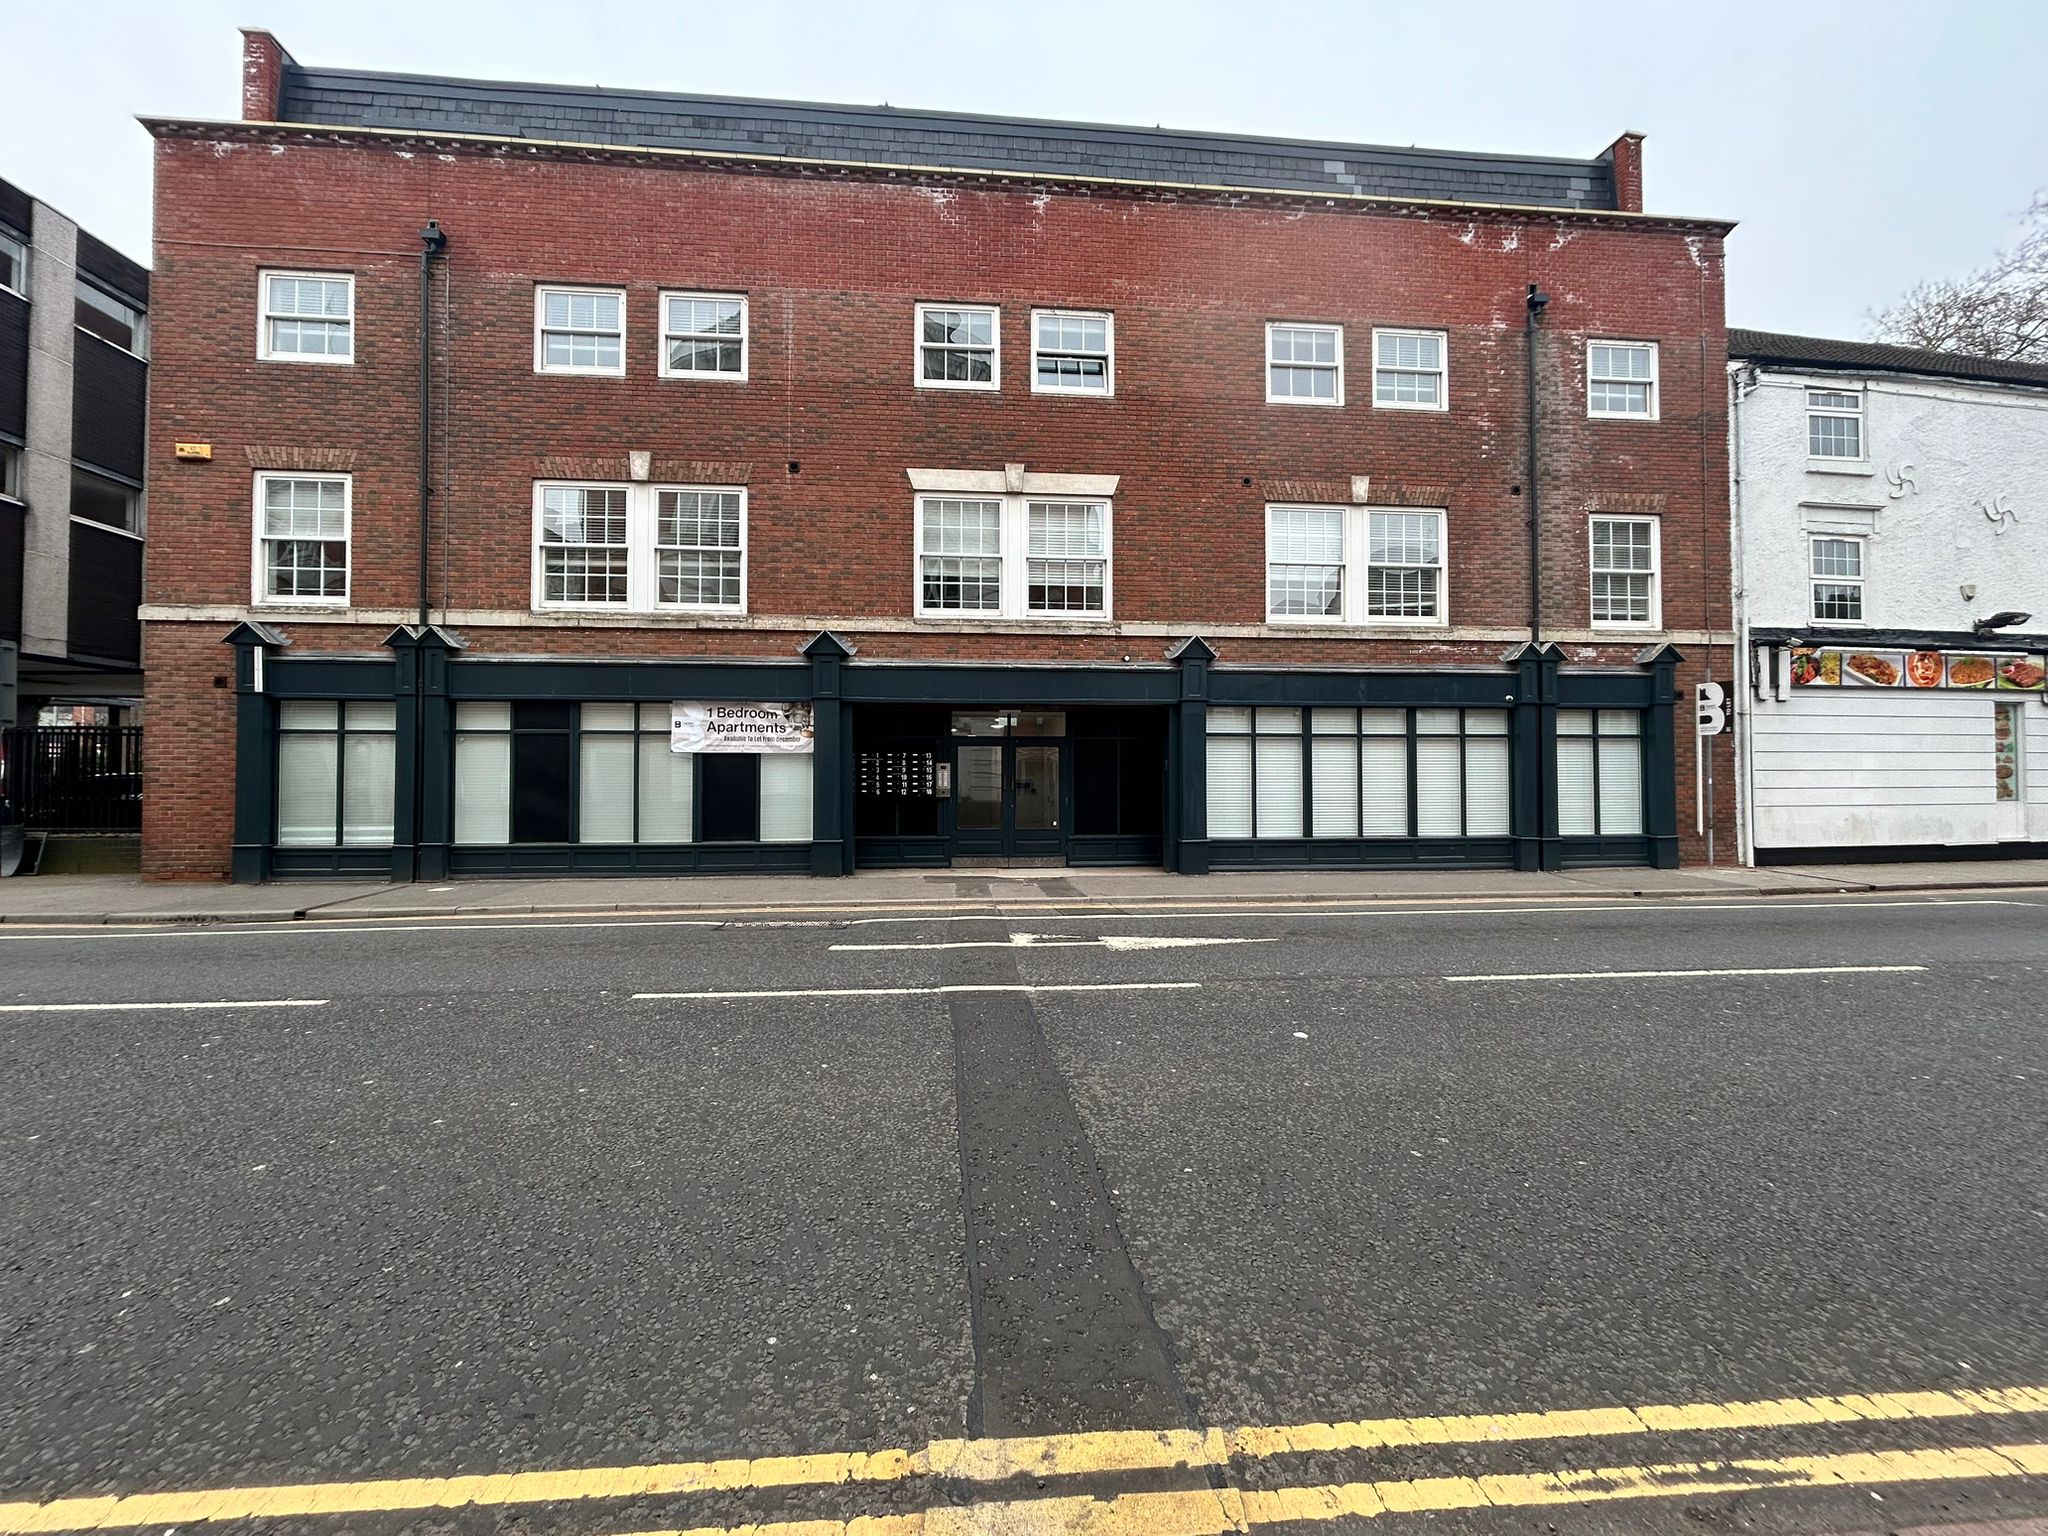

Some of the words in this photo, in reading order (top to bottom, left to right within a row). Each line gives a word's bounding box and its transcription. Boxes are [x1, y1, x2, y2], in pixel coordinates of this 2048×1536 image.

[707, 707, 712, 718] 1
[717, 707, 778, 719] Bedroom
[1726, 708, 1731, 716] TO
[674, 720, 682, 728] B
[706, 721, 787, 734] Apartments
